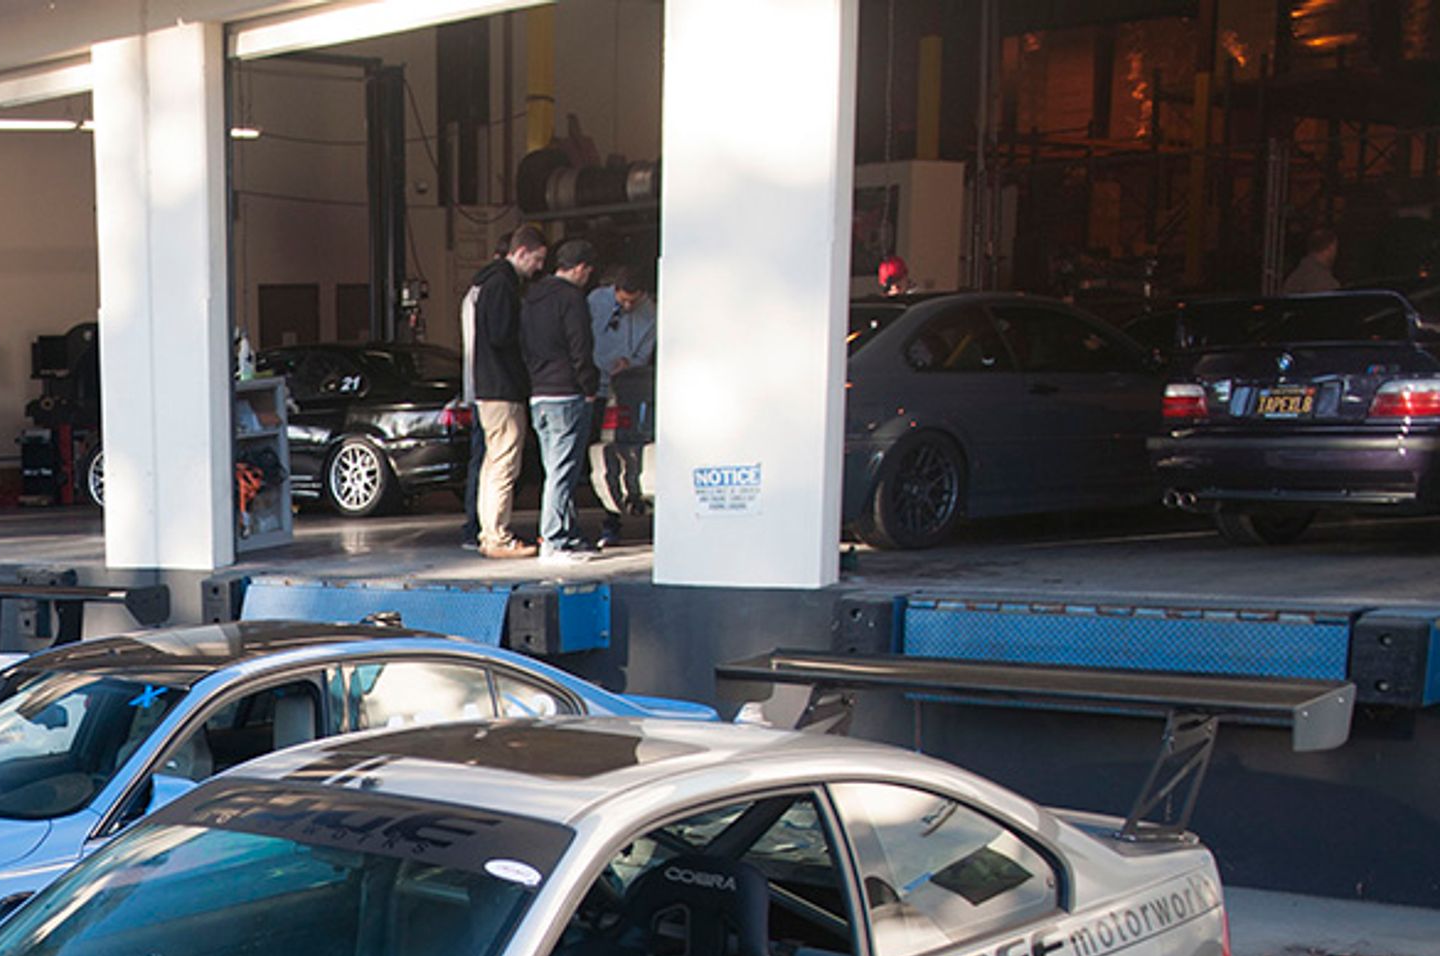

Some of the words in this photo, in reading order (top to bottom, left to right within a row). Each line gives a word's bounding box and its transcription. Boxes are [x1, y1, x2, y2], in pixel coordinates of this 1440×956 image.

[340, 376, 361, 391] 21
[695, 468, 759, 486] NOTICE
[664, 866, 737, 890] COBRA
